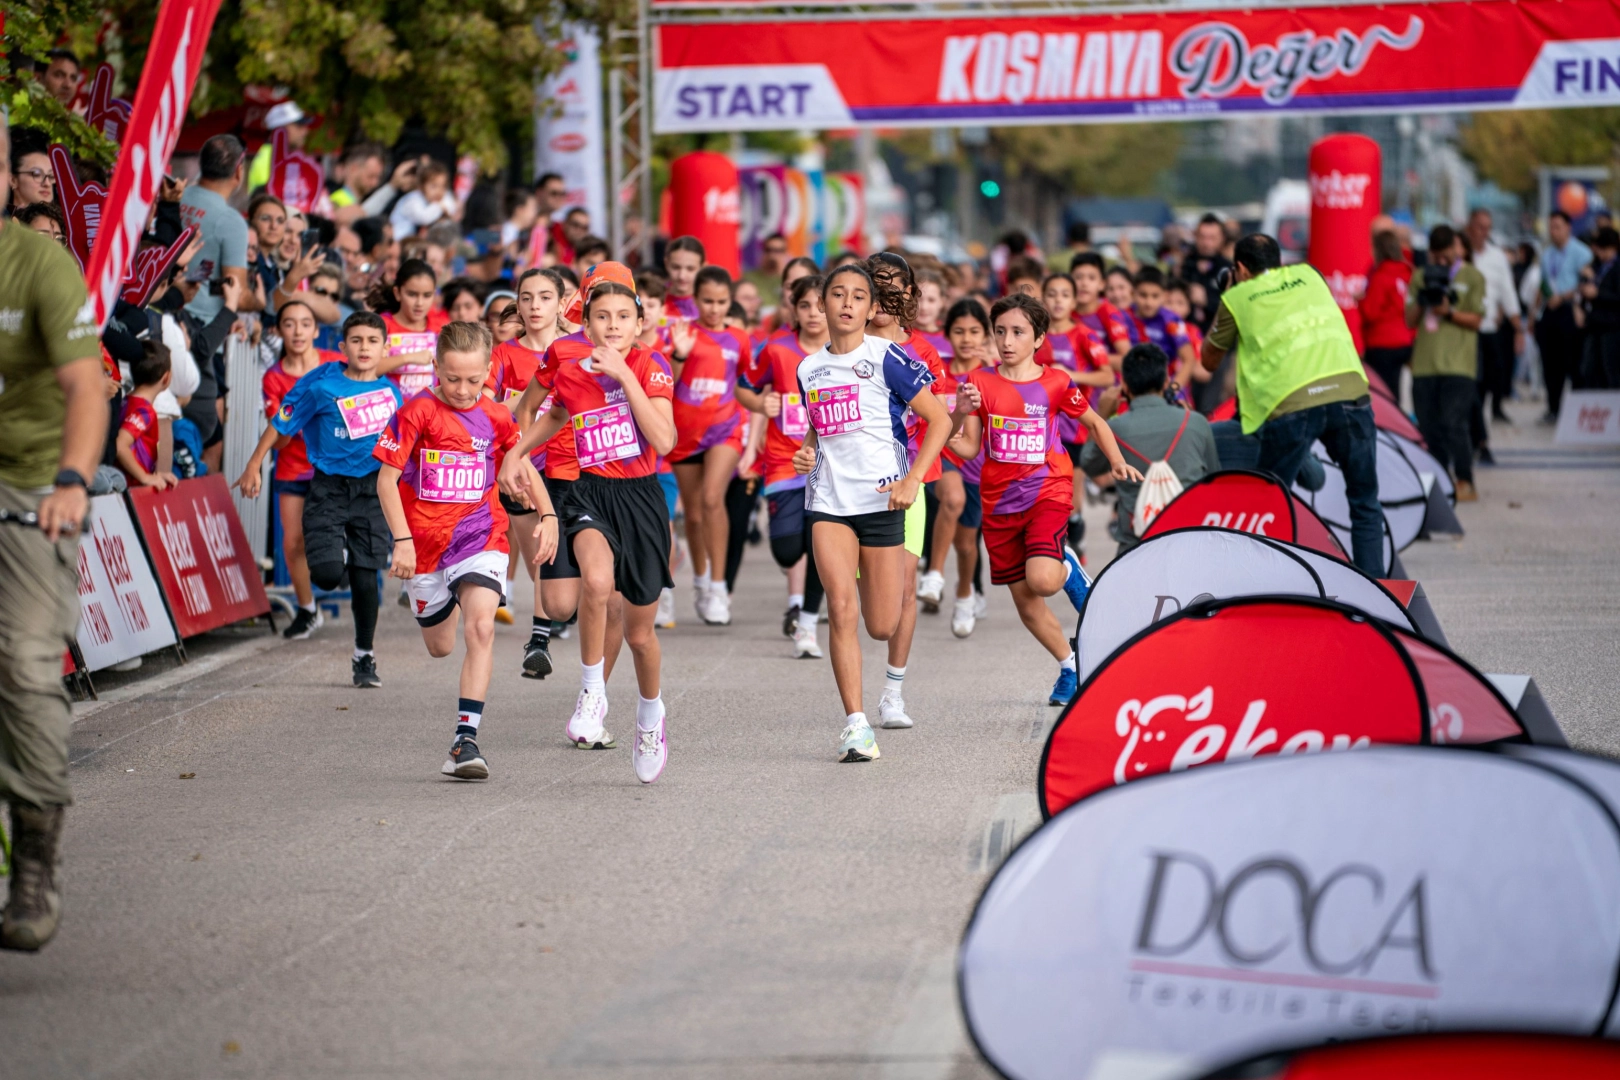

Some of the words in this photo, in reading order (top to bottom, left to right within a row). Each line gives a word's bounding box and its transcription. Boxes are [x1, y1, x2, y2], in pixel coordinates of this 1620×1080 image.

[937, 30, 1163, 105] KOŞMAYA
[1169, 15, 1424, 105] Değer
[677, 83, 812, 117] START
[820, 400, 859, 424] 11018
[584, 421, 634, 452] 11029
[1001, 433, 1044, 452] 11059
[437, 468, 484, 489] 11010
[1170, 699, 1372, 772] ek
